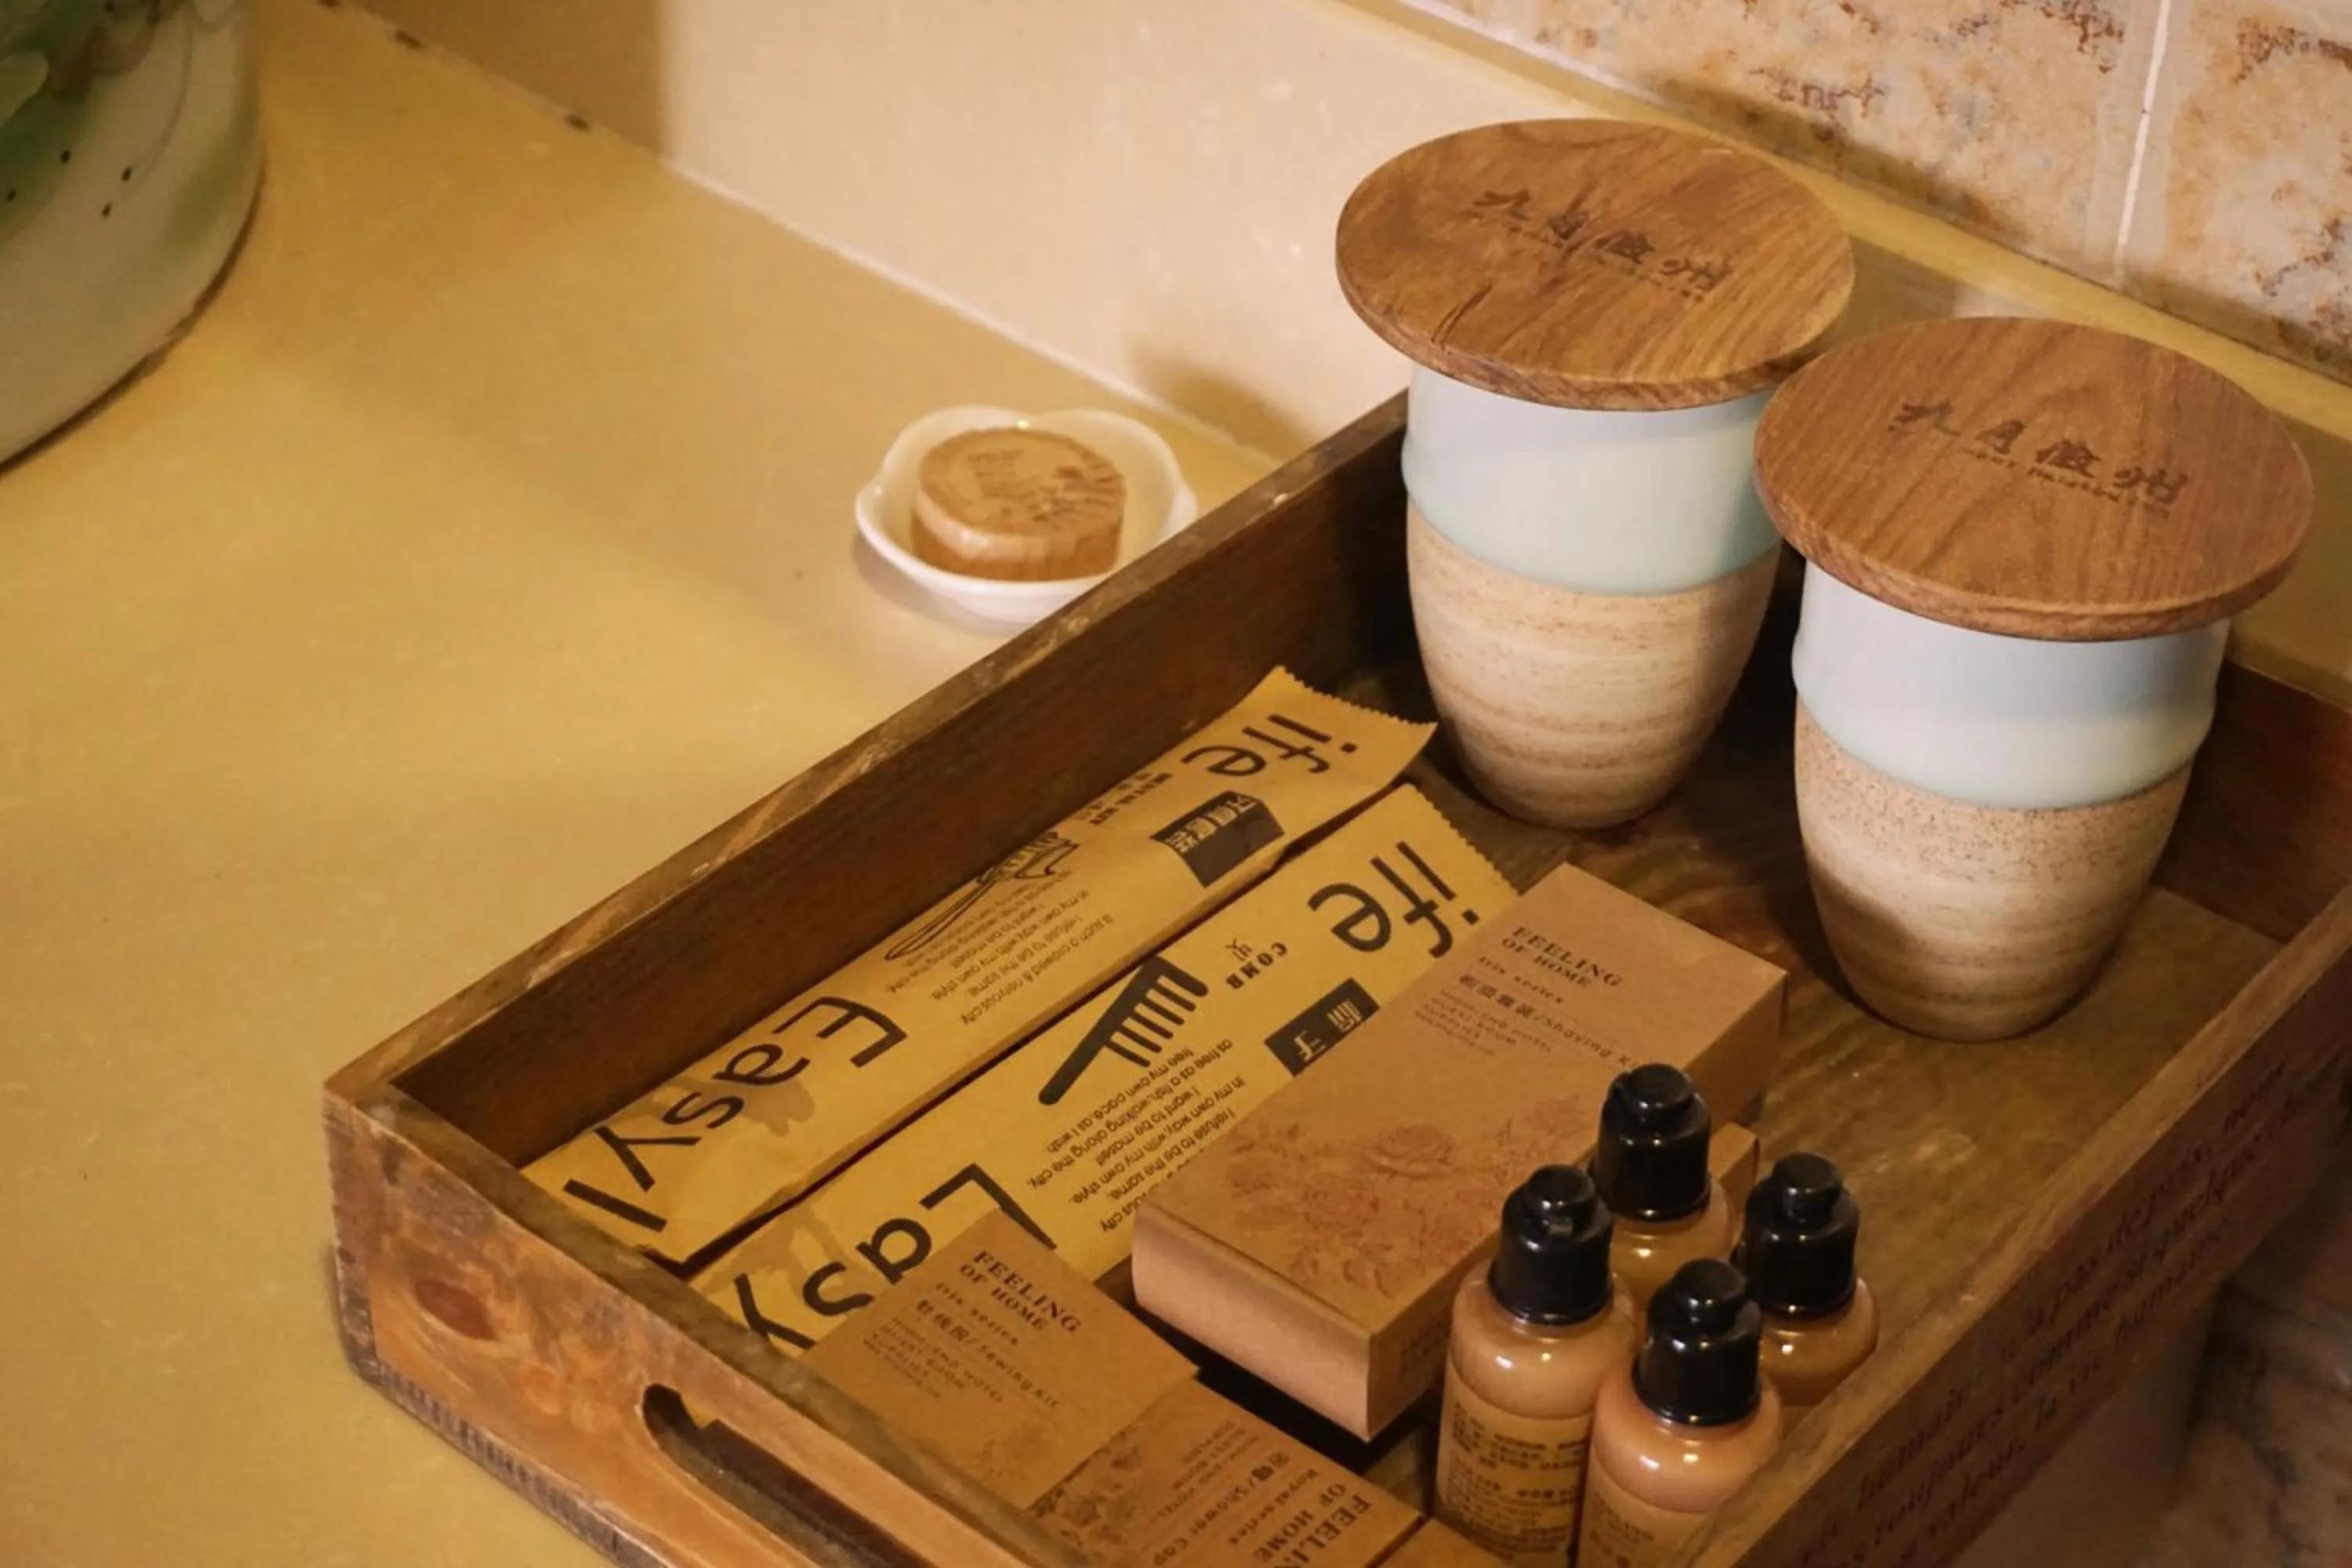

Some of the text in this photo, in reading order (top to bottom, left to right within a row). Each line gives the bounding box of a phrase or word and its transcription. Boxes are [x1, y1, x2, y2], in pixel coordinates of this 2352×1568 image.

[1307, 840, 1479, 958] ife
[1224, 939, 1289, 992] COMB
[1499, 936, 1592, 989] OF HOME
[1511, 925, 1623, 988] FEELING
[595, 996, 907, 1192] Easy
[1178, 1065, 1196, 1080] as
[1132, 1118, 1154, 1137] be
[1149, 1109, 1167, 1126] to
[1178, 1134, 1197, 1152] to
[1160, 1143, 1184, 1164] be
[956, 1263, 1051, 1331] OF HOME
[971, 1250, 1084, 1334] FEELING
[1253, 1480, 1347, 1563] OF HOME
[1282, 1493, 1370, 1566] FEELI
